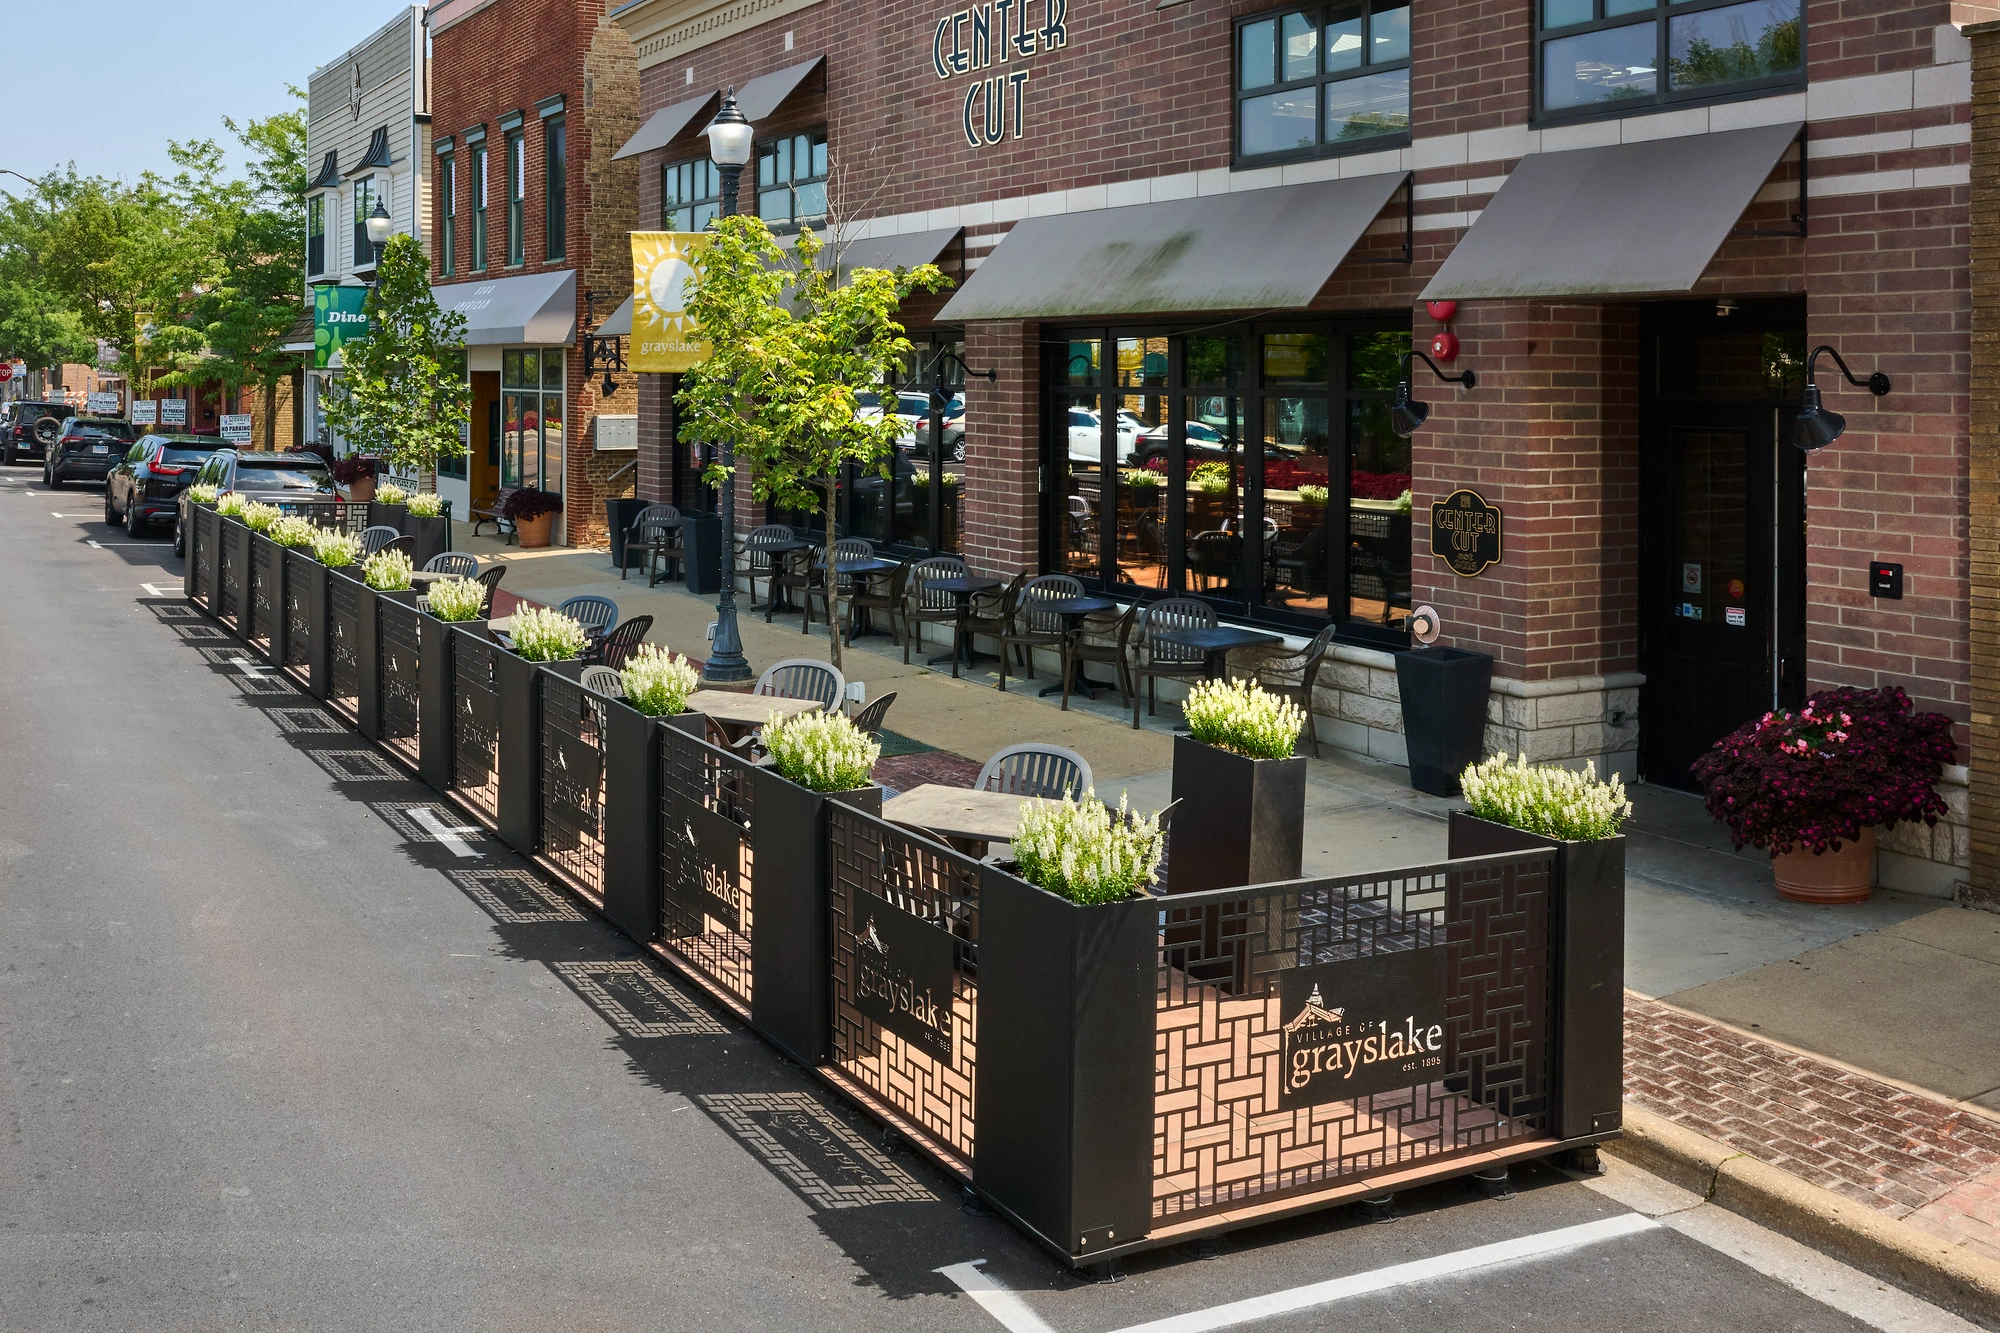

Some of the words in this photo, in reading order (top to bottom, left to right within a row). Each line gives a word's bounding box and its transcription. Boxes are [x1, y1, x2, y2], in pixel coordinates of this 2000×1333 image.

[932, 0, 1068, 79] CENTER
[962, 69, 1030, 148] CUT
[327, 310, 367, 323] Dine
[453, 298, 493, 311] AMERICAN
[640, 338, 702, 356] grayslake
[1435, 508, 1496, 534] CENTER
[1451, 530, 1480, 552] CUT
[859, 963, 951, 1037] grayslake
[1296, 1025, 1351, 1044] VILLAGE
[1359, 1020, 1373, 1033] OF
[1290, 1015, 1443, 1089] grayslake
[1402, 1061, 1418, 1072] est.
[1421, 1056, 1441, 1067] 1895
